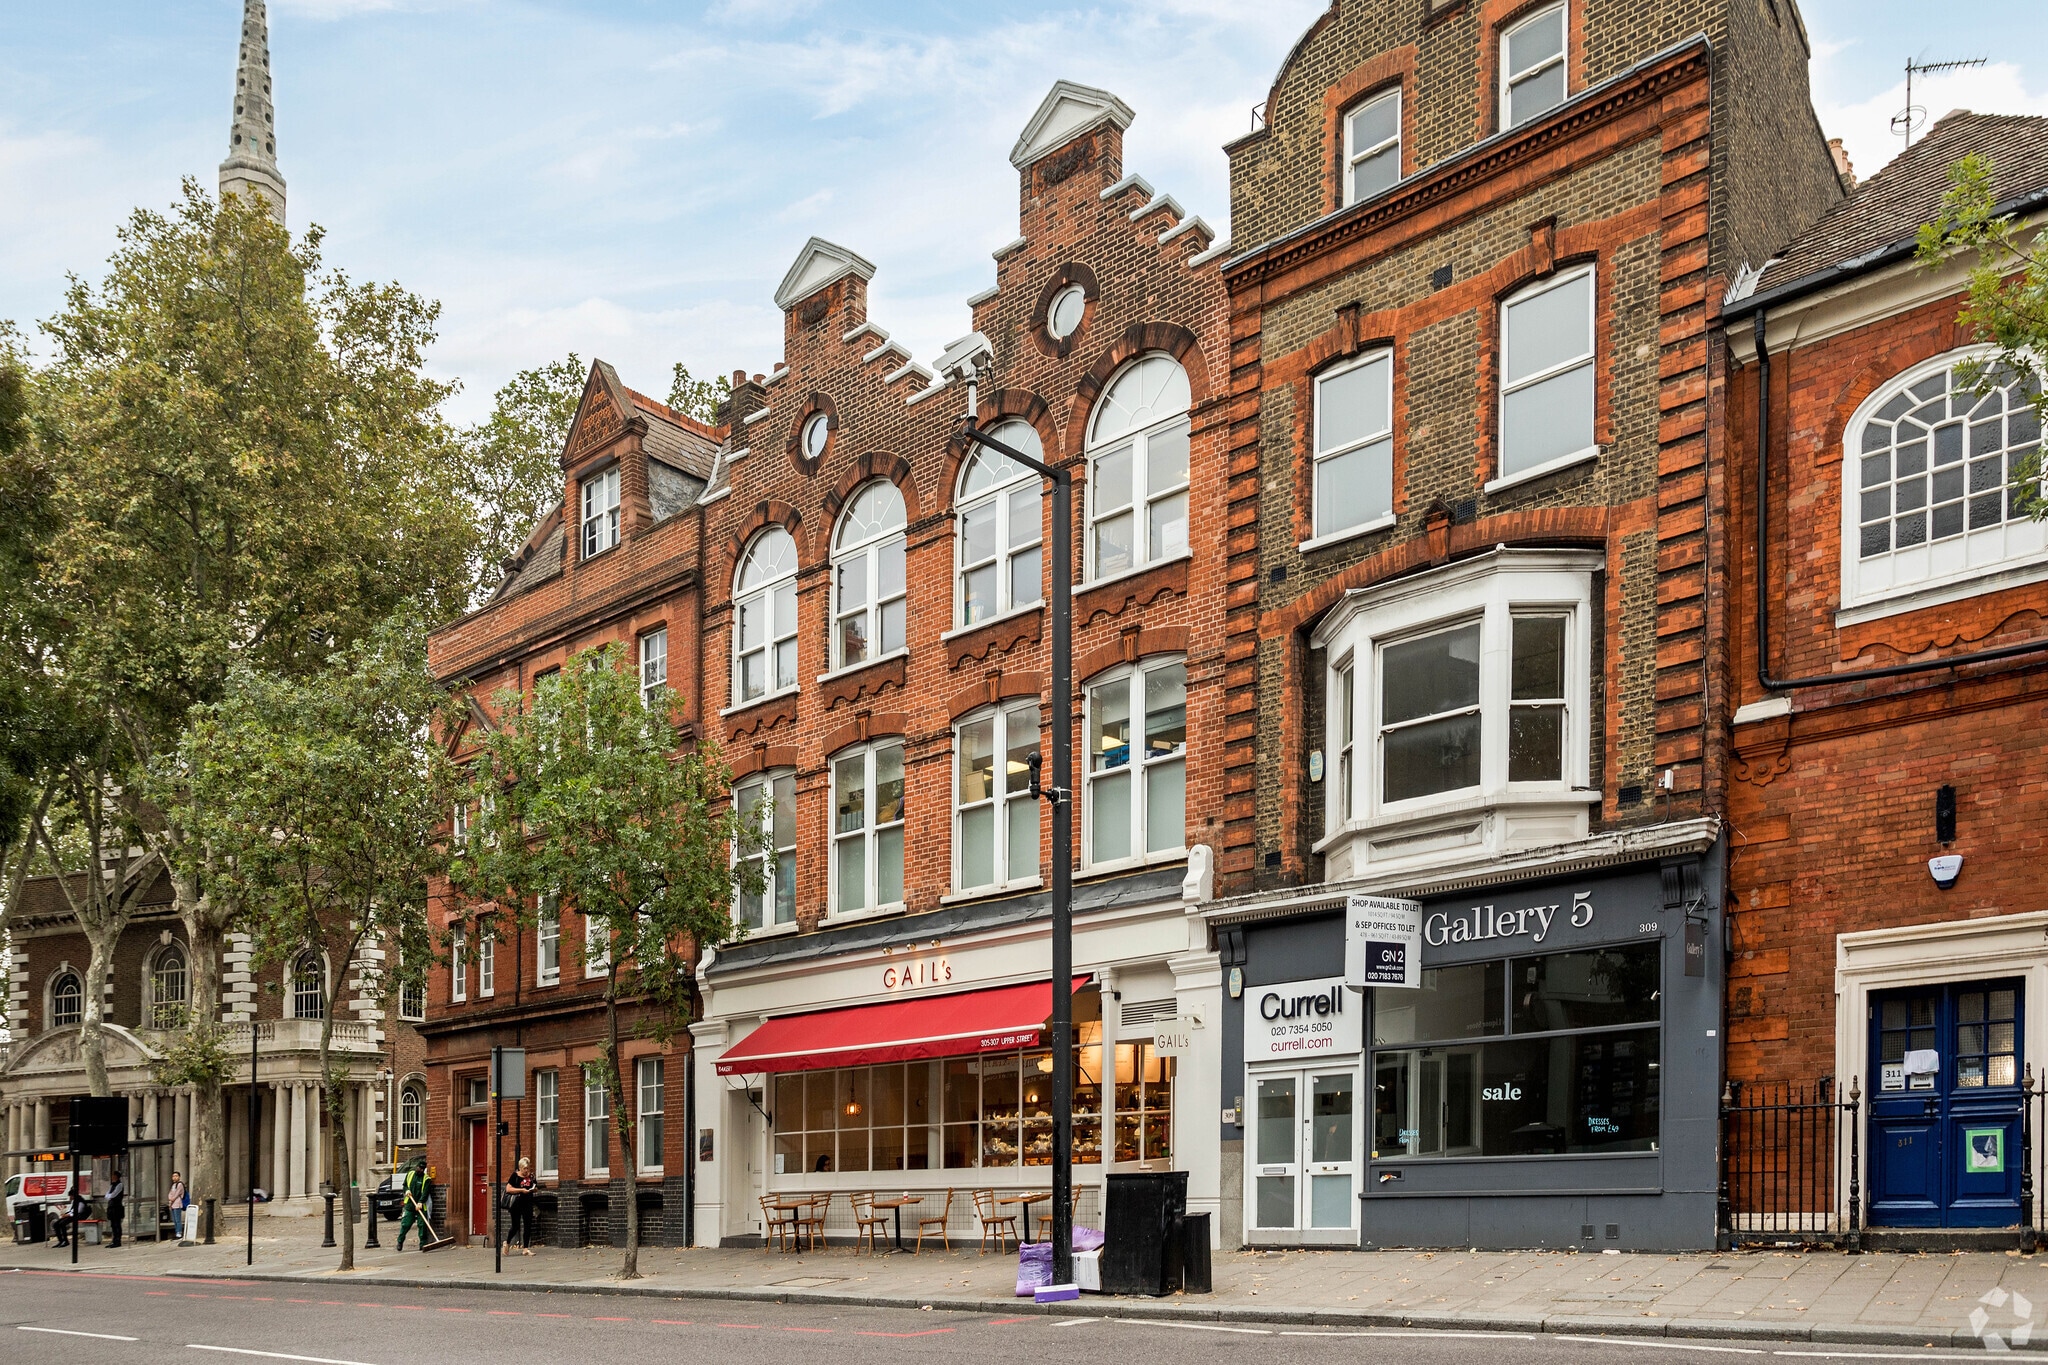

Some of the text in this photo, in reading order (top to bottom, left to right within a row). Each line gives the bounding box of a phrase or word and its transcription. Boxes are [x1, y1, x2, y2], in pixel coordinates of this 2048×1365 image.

[1352, 899, 1368, 908] SHOP
[1369, 900, 1400, 910] AVAILABLE
[1424, 890, 1594, 946] Gallery 5
[1372, 922, 1396, 931] OFFICES
[1639, 922, 1658, 933] 309
[1686, 942, 1700, 958] Gallery
[1260, 985, 1343, 1020] Currell
[1271, 1022, 1332, 1036] 020 7354 5050
[981, 1034, 1033, 1047] 305-307 UPPER STREET
[1271, 1037, 1332, 1052] currell.com
[1885, 1070, 1901, 1078] 311
[1482, 1082, 1522, 1101] sale
[1588, 1116, 1609, 1126] DRESSES
[1608, 1124, 1619, 1133] £49
[1898, 1136, 1912, 1147] 311
